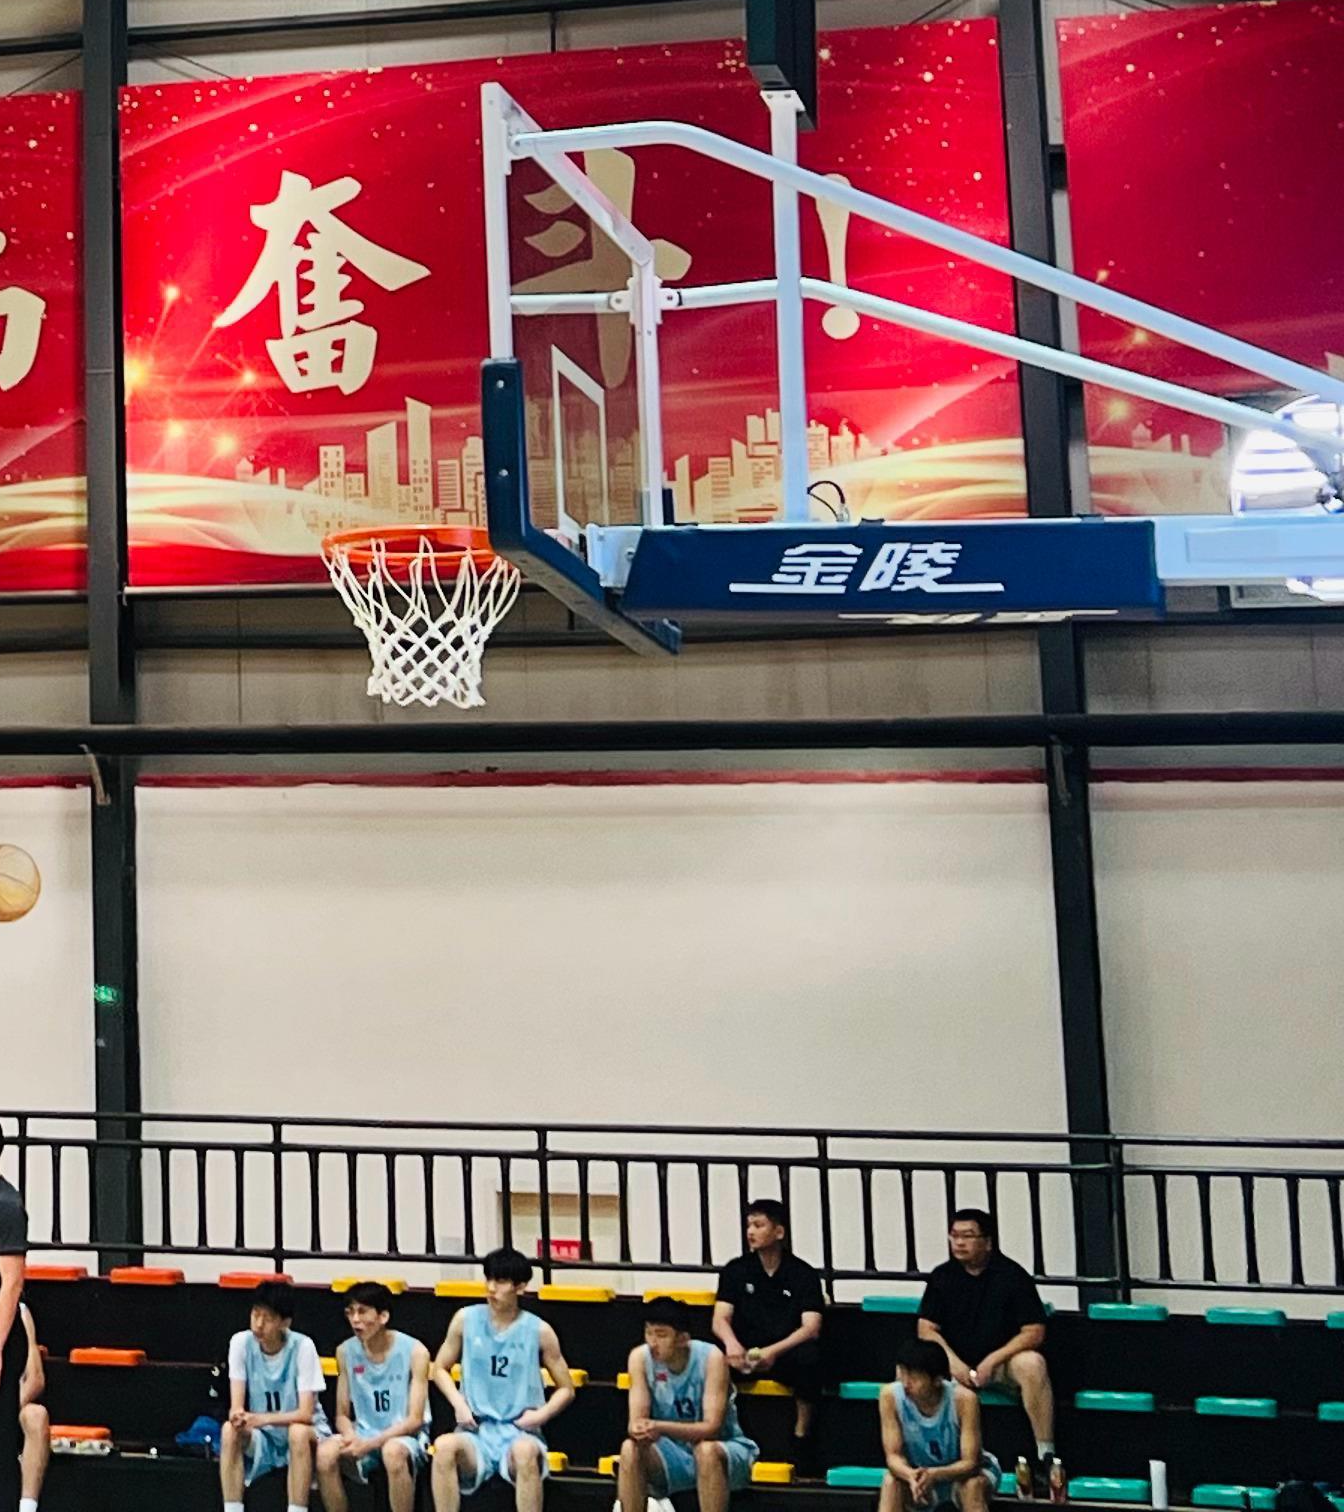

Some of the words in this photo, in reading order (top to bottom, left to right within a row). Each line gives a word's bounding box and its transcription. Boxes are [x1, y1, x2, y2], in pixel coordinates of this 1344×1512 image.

[730, 542, 1004, 594] 金陵
[490, 1355, 509, 1378] 12
[373, 1390, 390, 1412] 16
